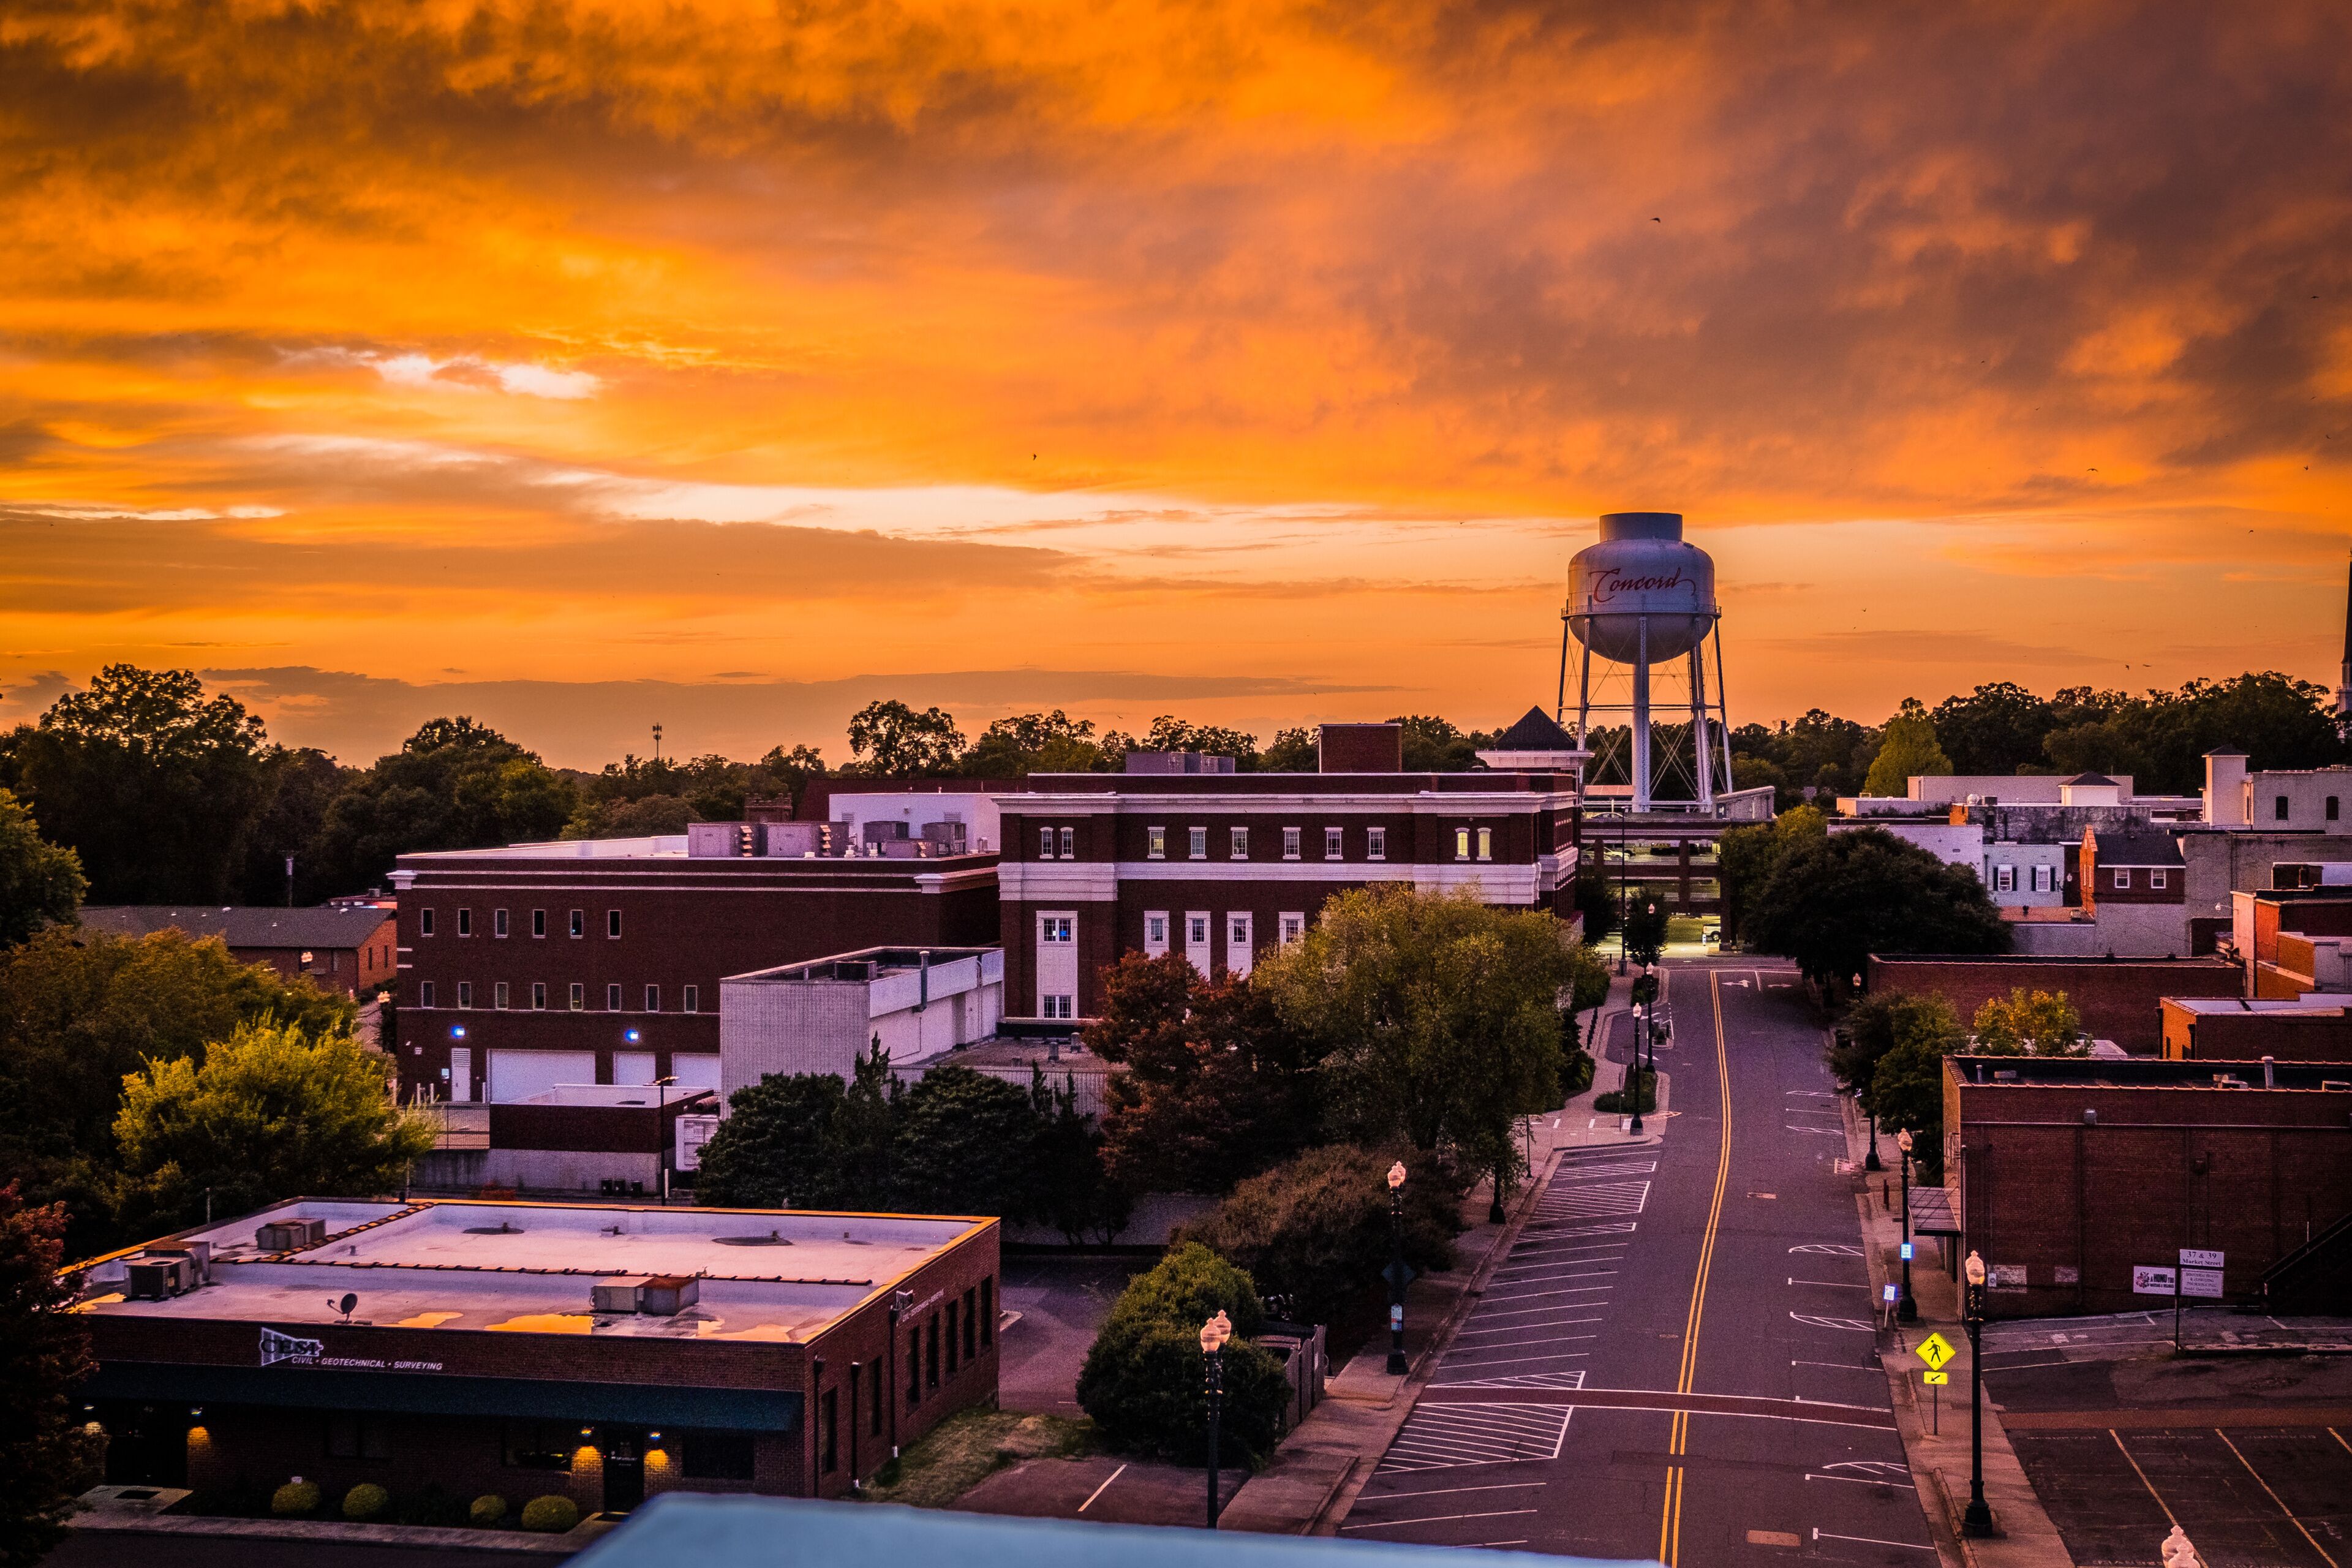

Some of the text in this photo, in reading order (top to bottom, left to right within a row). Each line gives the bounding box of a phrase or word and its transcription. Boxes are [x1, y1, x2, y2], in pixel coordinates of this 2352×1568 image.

[1588, 567, 1696, 603] Concord
[292, 1356, 443, 1370] CIVIL GEOTECHNICAL SURVEYING
